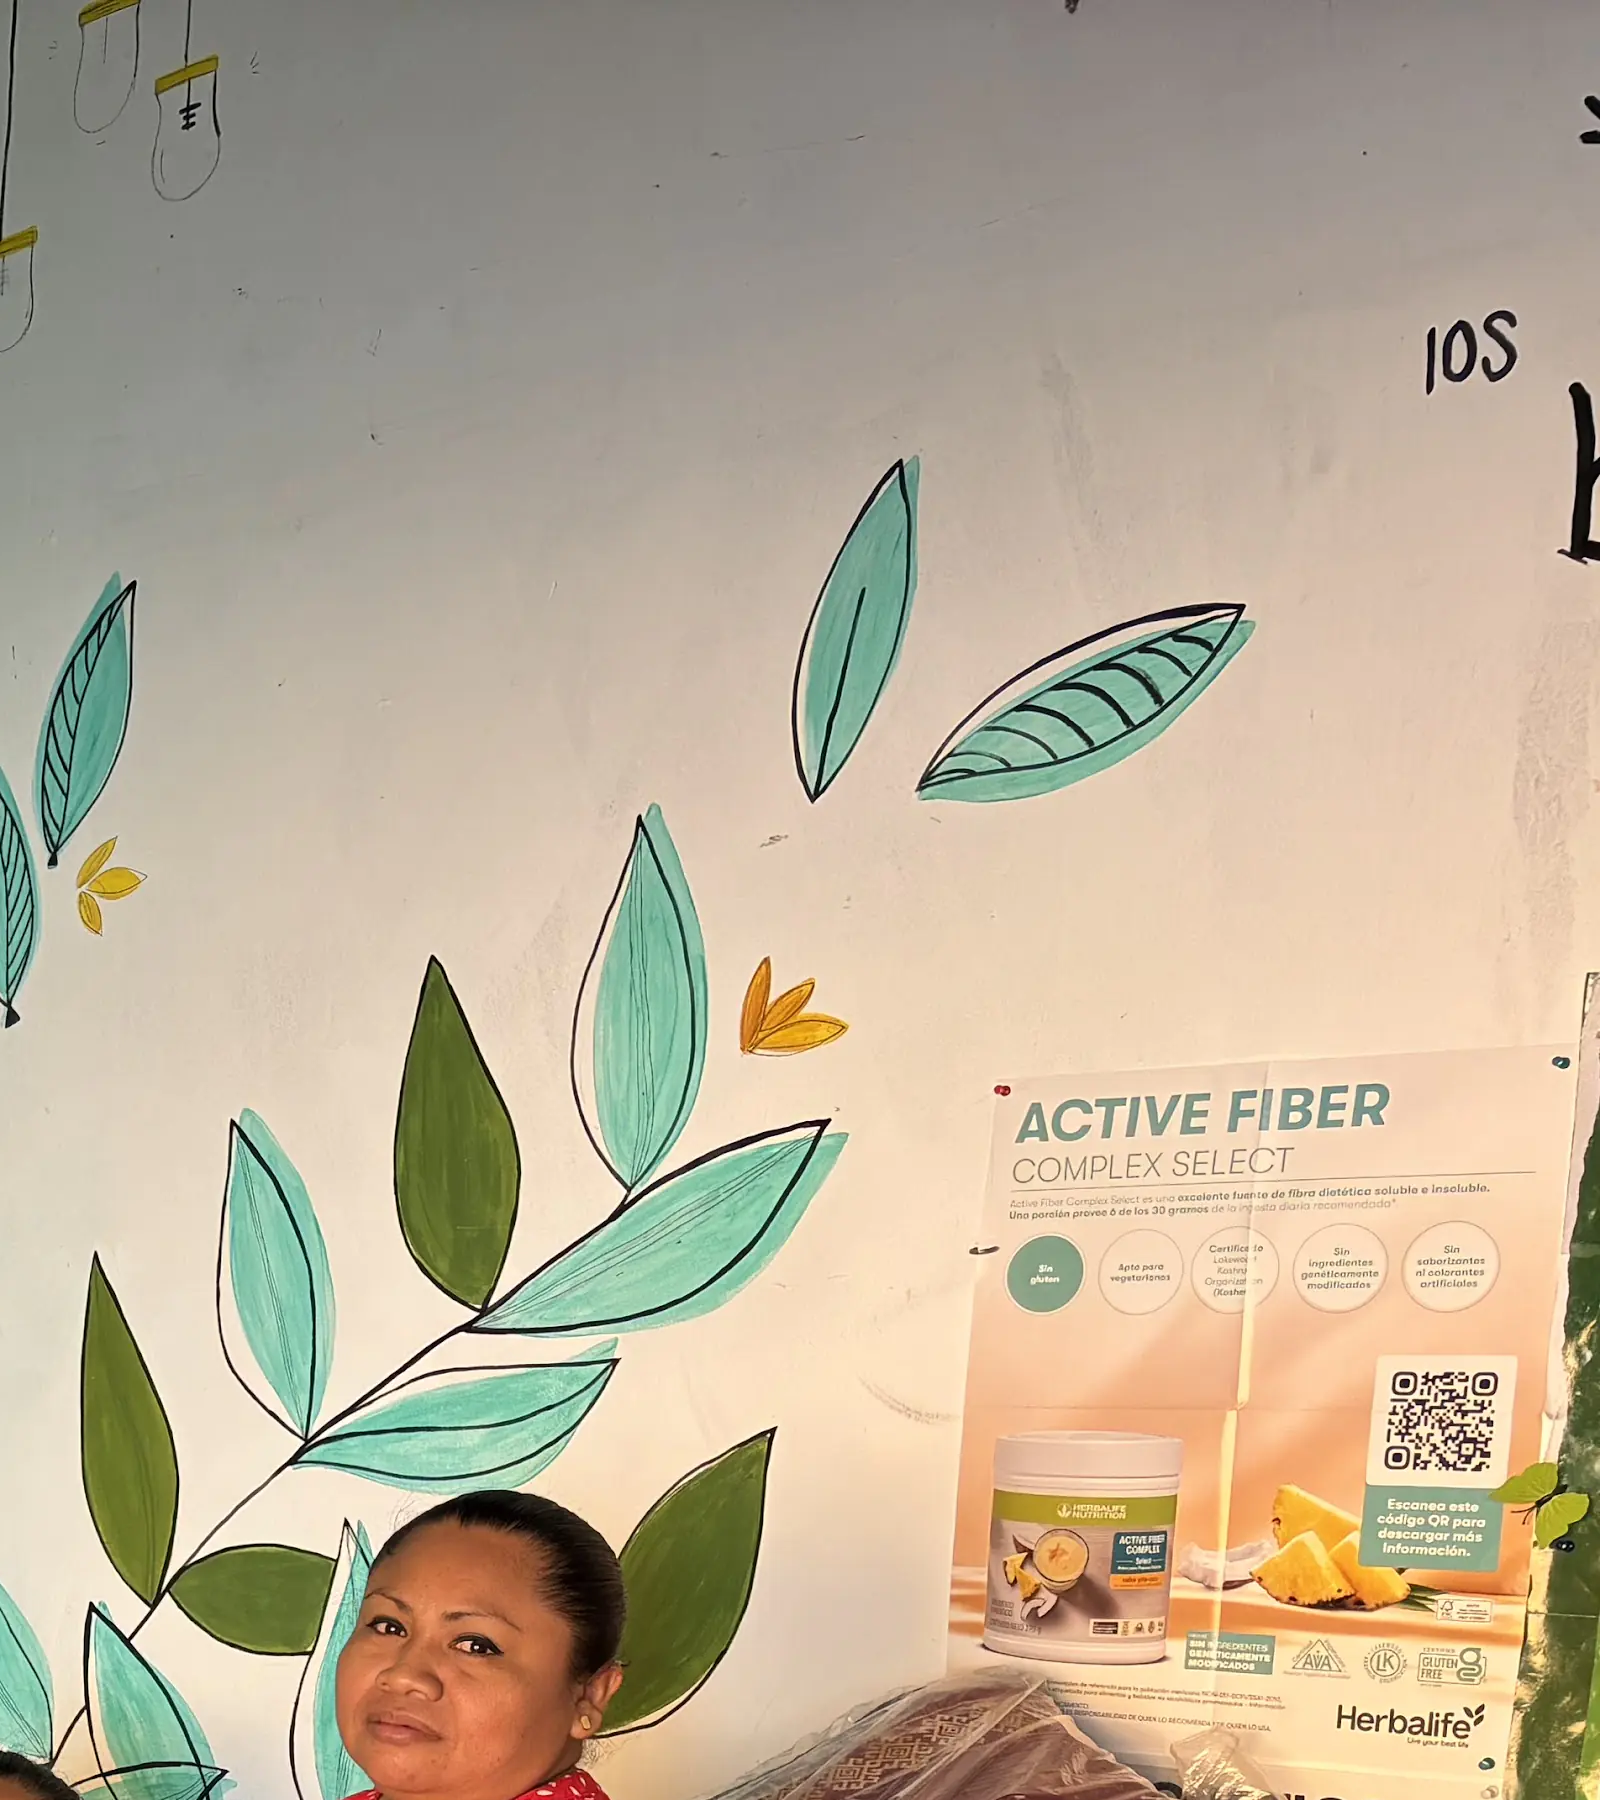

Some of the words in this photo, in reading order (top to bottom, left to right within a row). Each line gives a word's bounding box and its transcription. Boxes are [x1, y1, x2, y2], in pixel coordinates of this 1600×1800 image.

[1014, 1092, 1211, 1144] ACTIVE
[1226, 1082, 1391, 1134] FIBER
[1011, 1151, 1164, 1185] COMPLEX
[1171, 1146, 1295, 1178] SELECT
[1374, 1185, 1419, 1196] soluble
[1151, 1205, 1167, 1215] 30
[1333, 1247, 1350, 1256] Sin
[1443, 1245, 1460, 1254] Sin
[1038, 1264, 1054, 1274] Sin
[1308, 1258, 1374, 1269] ingredientes
[1427, 1267, 1485, 1277] colorantes
[1029, 1275, 1060, 1286] gluten
[1387, 1498, 1446, 1512] Escanea
[1448, 1501, 1480, 1513] este
[1377, 1513, 1425, 1528] código
[1427, 1514, 1451, 1528] QR
[1452, 1518, 1486, 1530] para
[1377, 1527, 1451, 1544] descargar
[1452, 1531, 1484, 1543] más
[1382, 1541, 1471, 1557] información.
[1421, 1656, 1458, 1670] GLUTEN
[1420, 1668, 1443, 1680] FREE
[1336, 1704, 1471, 1740] Herbalife
